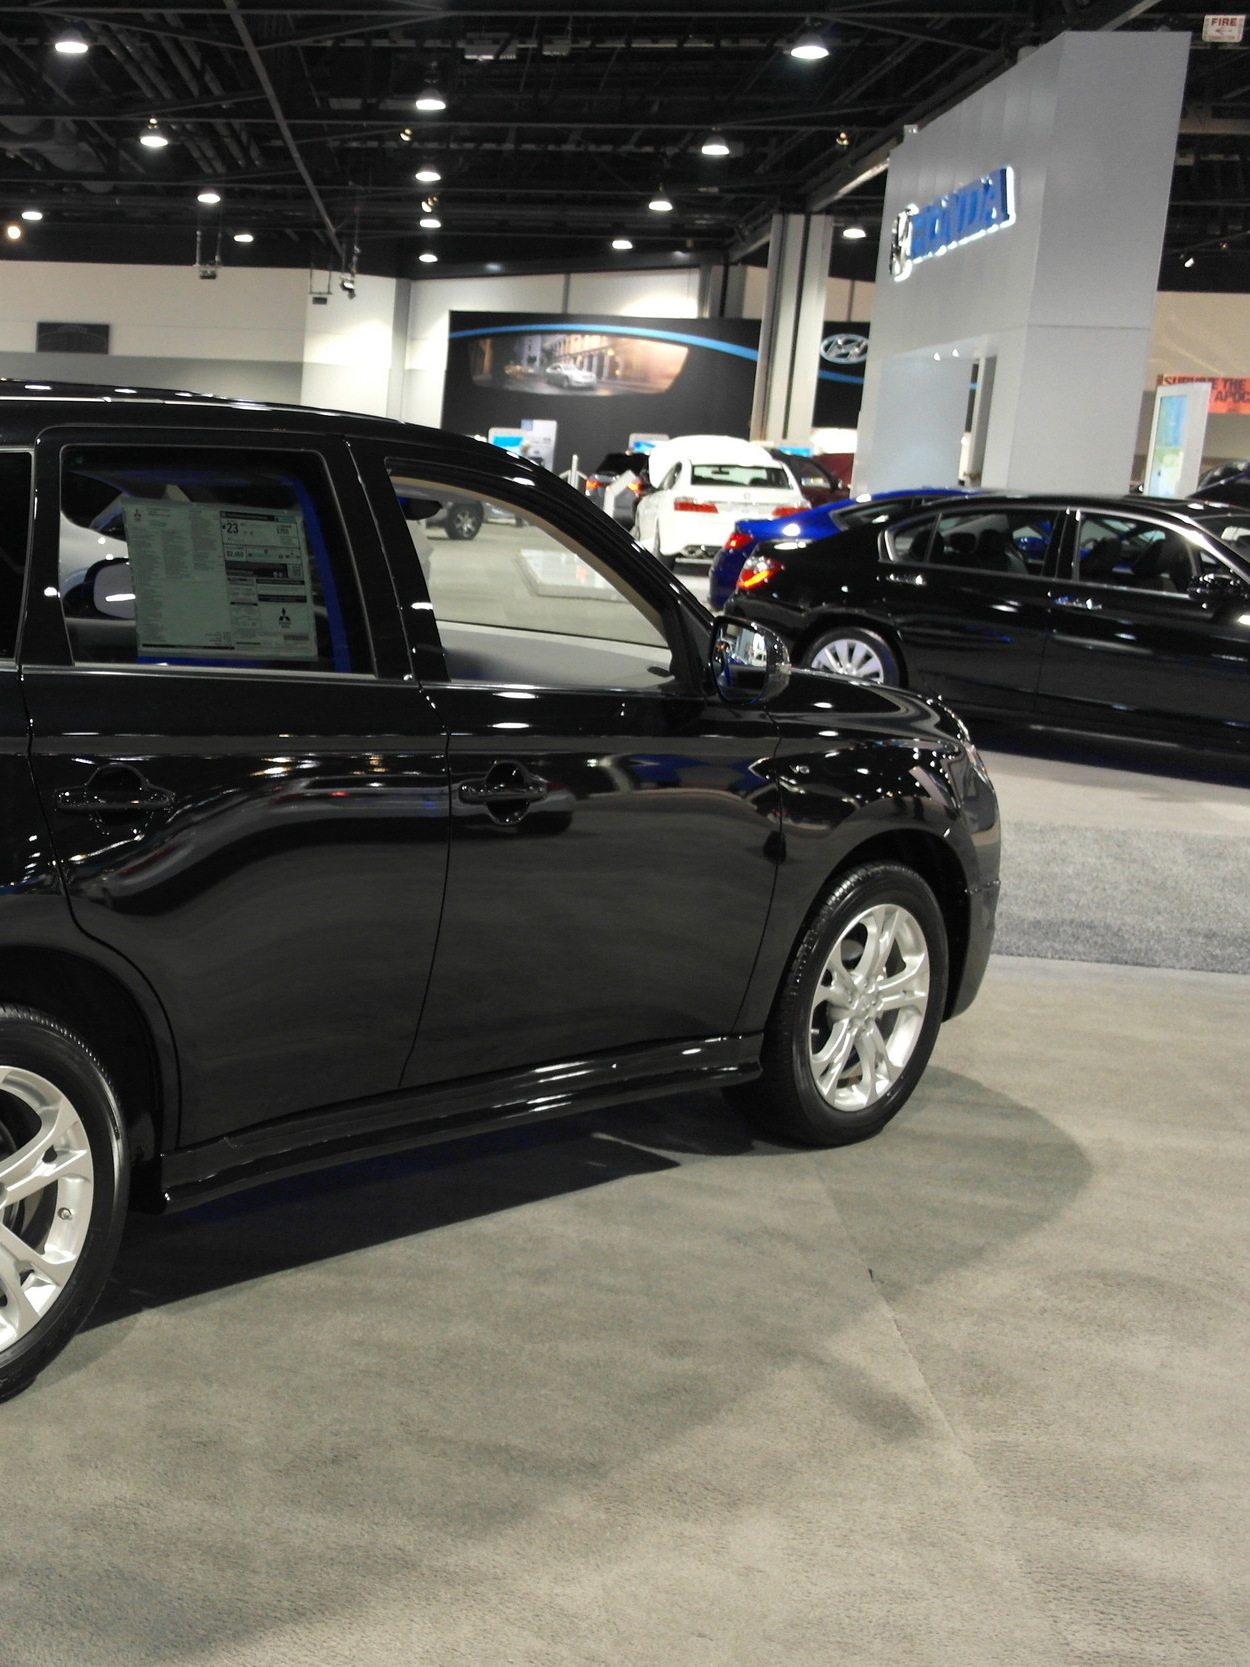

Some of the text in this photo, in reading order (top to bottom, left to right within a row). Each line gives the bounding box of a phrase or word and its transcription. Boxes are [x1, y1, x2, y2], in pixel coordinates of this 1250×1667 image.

[1211, 17, 1237, 26] FIRE
[1223, 378, 1247, 390] THE
[226, 522, 239, 534] 23
